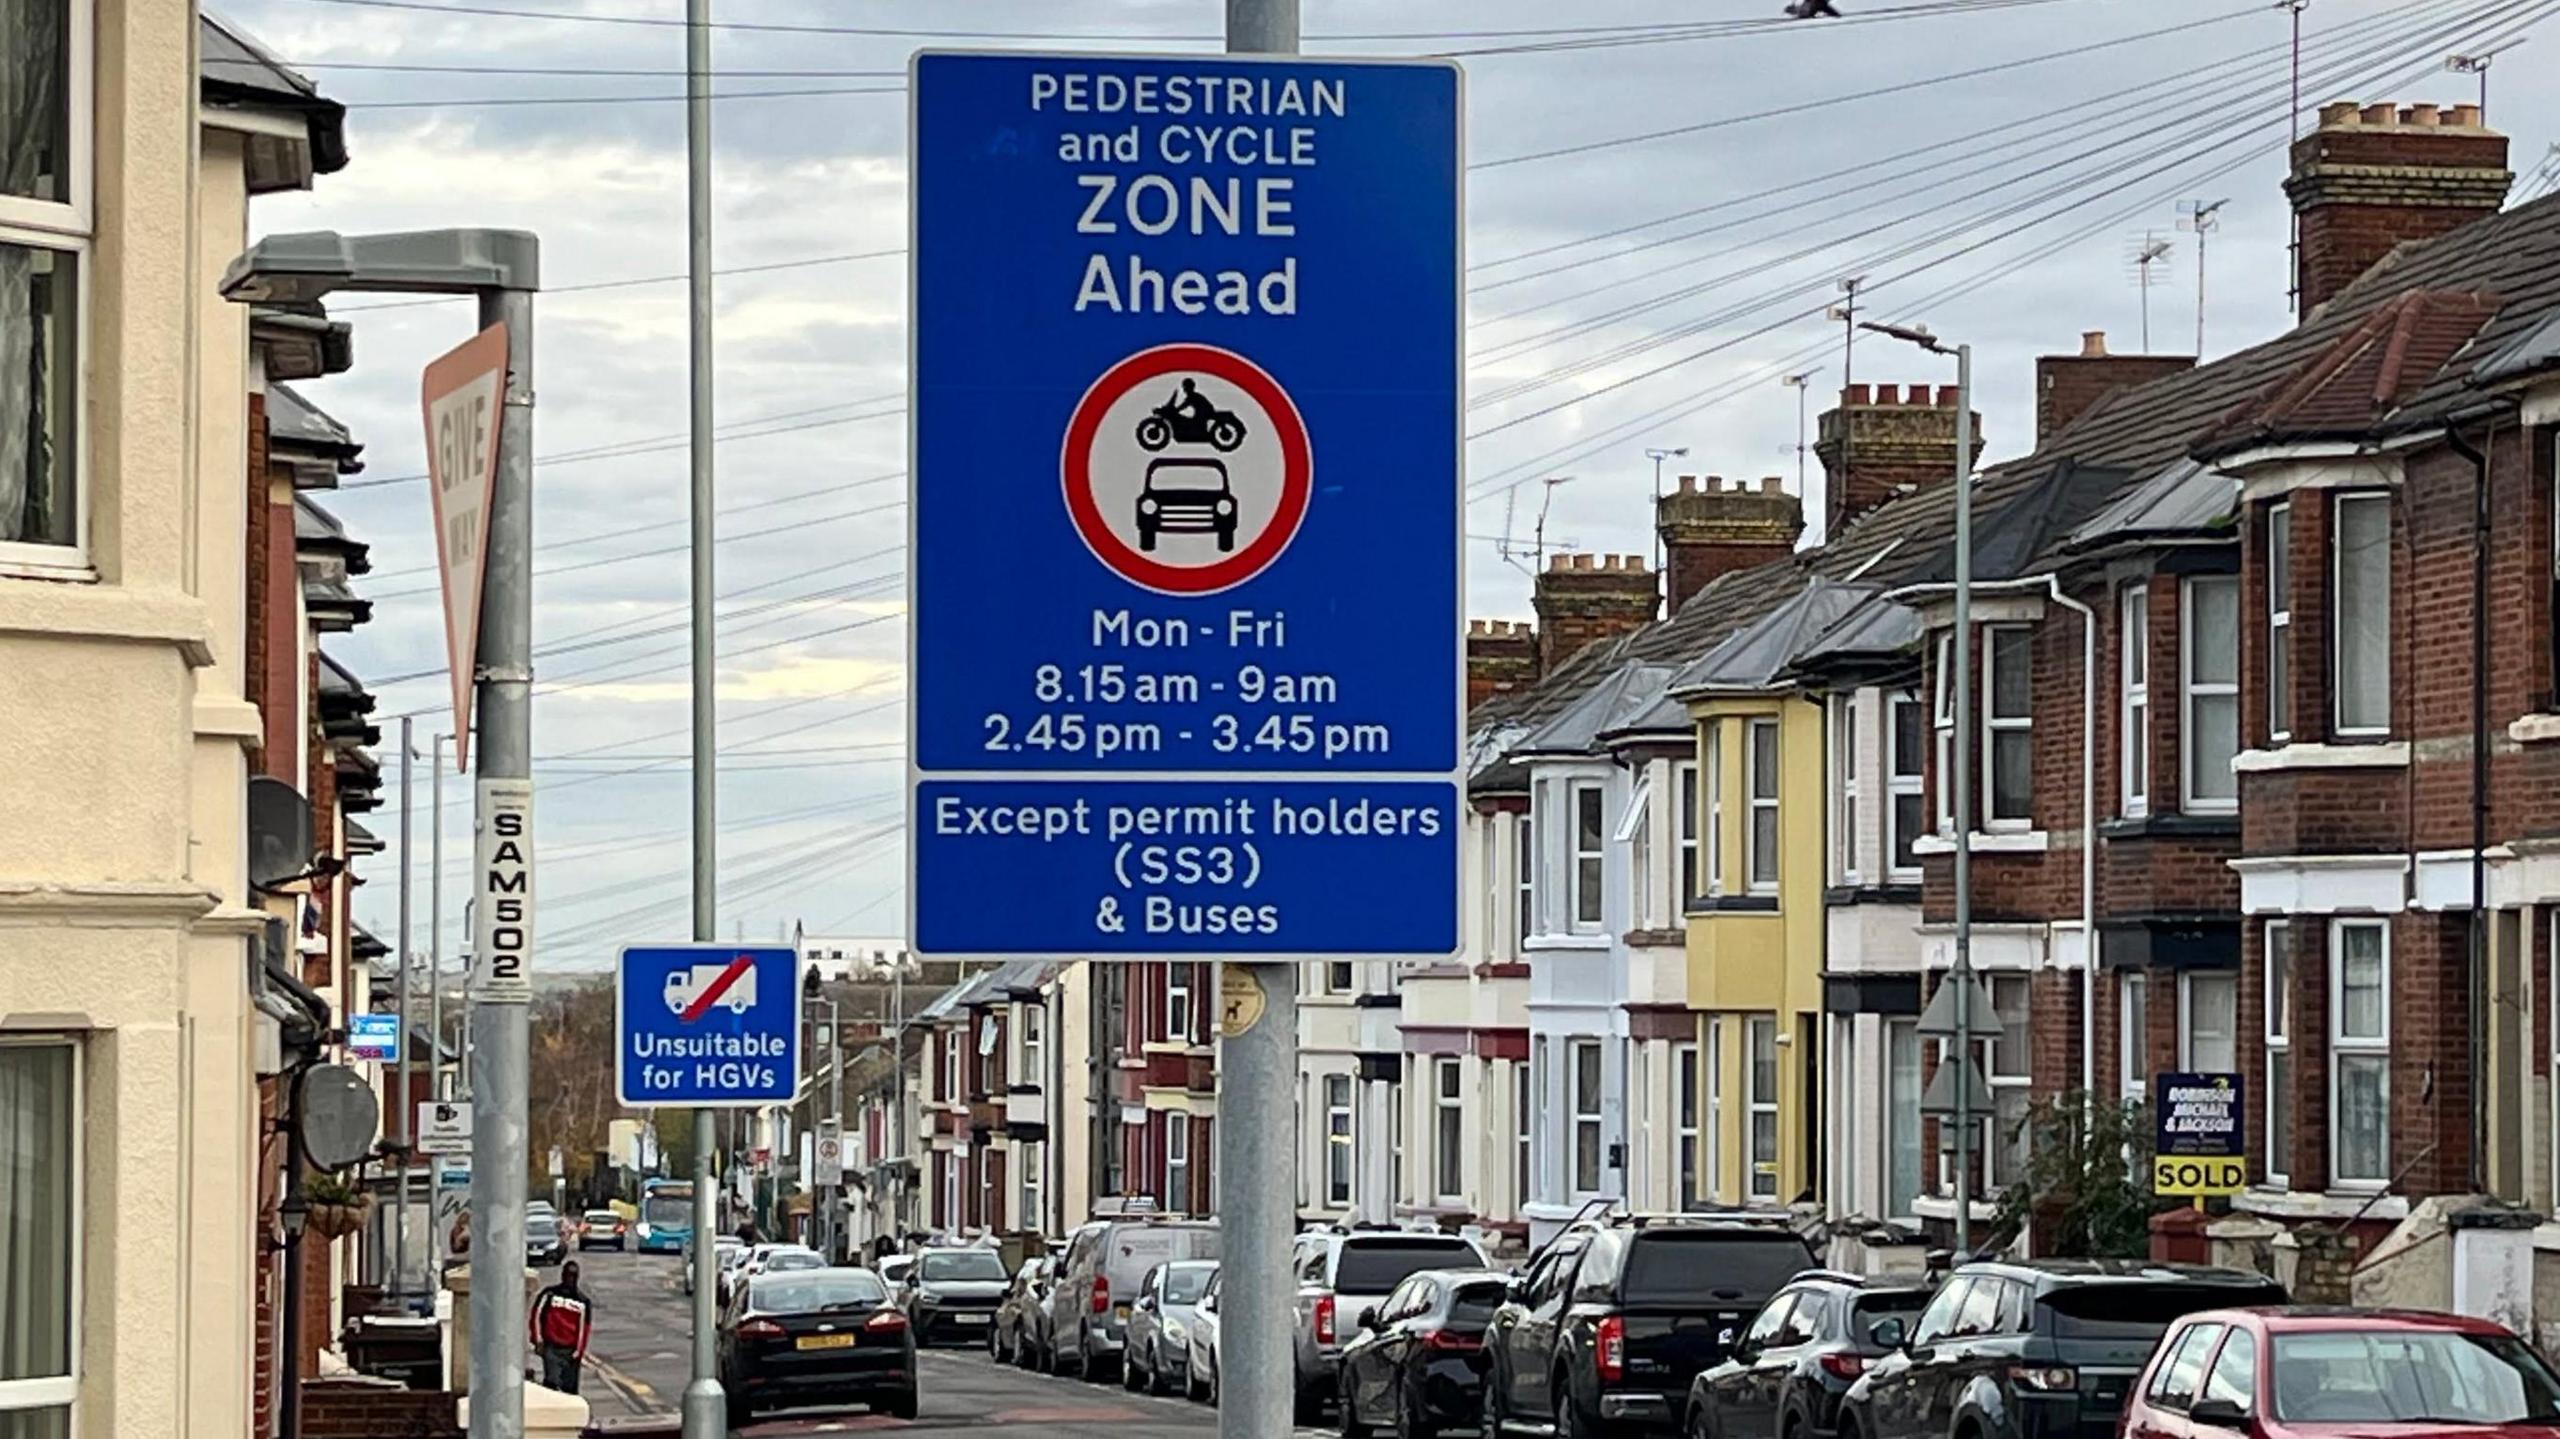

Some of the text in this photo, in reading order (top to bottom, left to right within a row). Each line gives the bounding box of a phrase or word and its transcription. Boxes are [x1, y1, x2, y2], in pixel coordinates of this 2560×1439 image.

[1032, 73, 1346, 117] PEDESTRIAN
[1058, 125, 1317, 166] and CYCLE
[1076, 174, 1297, 237] ZONE
[1074, 254, 1297, 316] Ahead
[438, 395, 487, 492] GIVE
[448, 507, 481, 567] WAY
[1093, 609, 1189, 647] Mon
[1229, 610, 1285, 647] Fri
[936, 797, 1441, 842] Except permit holders
[1114, 841, 1262, 889] (SS3)
[488, 813, 527, 978] SAM502
[1096, 896, 1279, 934] & Buses
[634, 1031, 787, 1058] Unsuitable
[642, 1063, 776, 1090] for HGVs
[2157, 1164, 2243, 1188] SOLD
